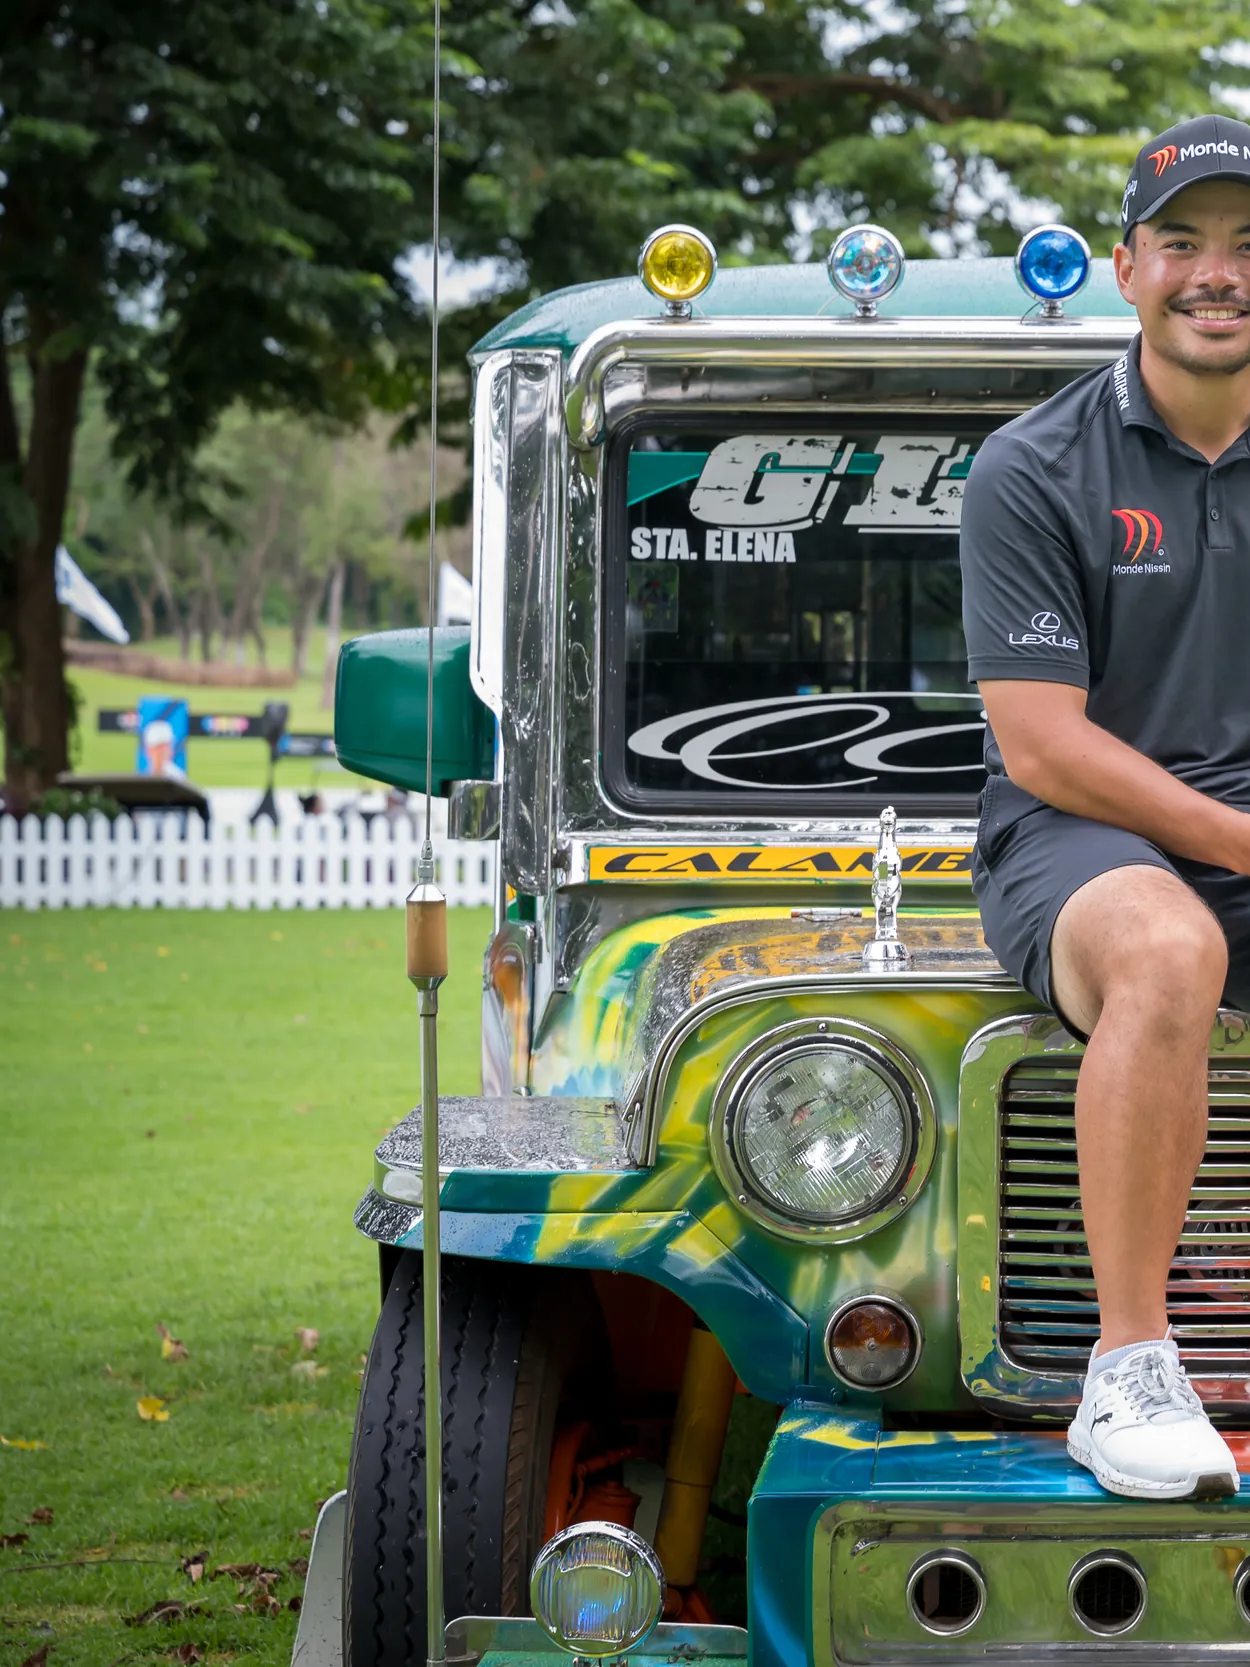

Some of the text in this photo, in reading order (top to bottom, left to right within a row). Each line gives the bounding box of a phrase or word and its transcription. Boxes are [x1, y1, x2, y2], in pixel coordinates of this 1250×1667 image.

[1180, 139, 1239, 162] Monde
[1113, 351, 1130, 412] MATHEW
[631, 526, 796, 563] STA. ELENA
[1113, 562, 1171, 575] Monde Nissin
[1008, 632, 1079, 650] LEXUS
